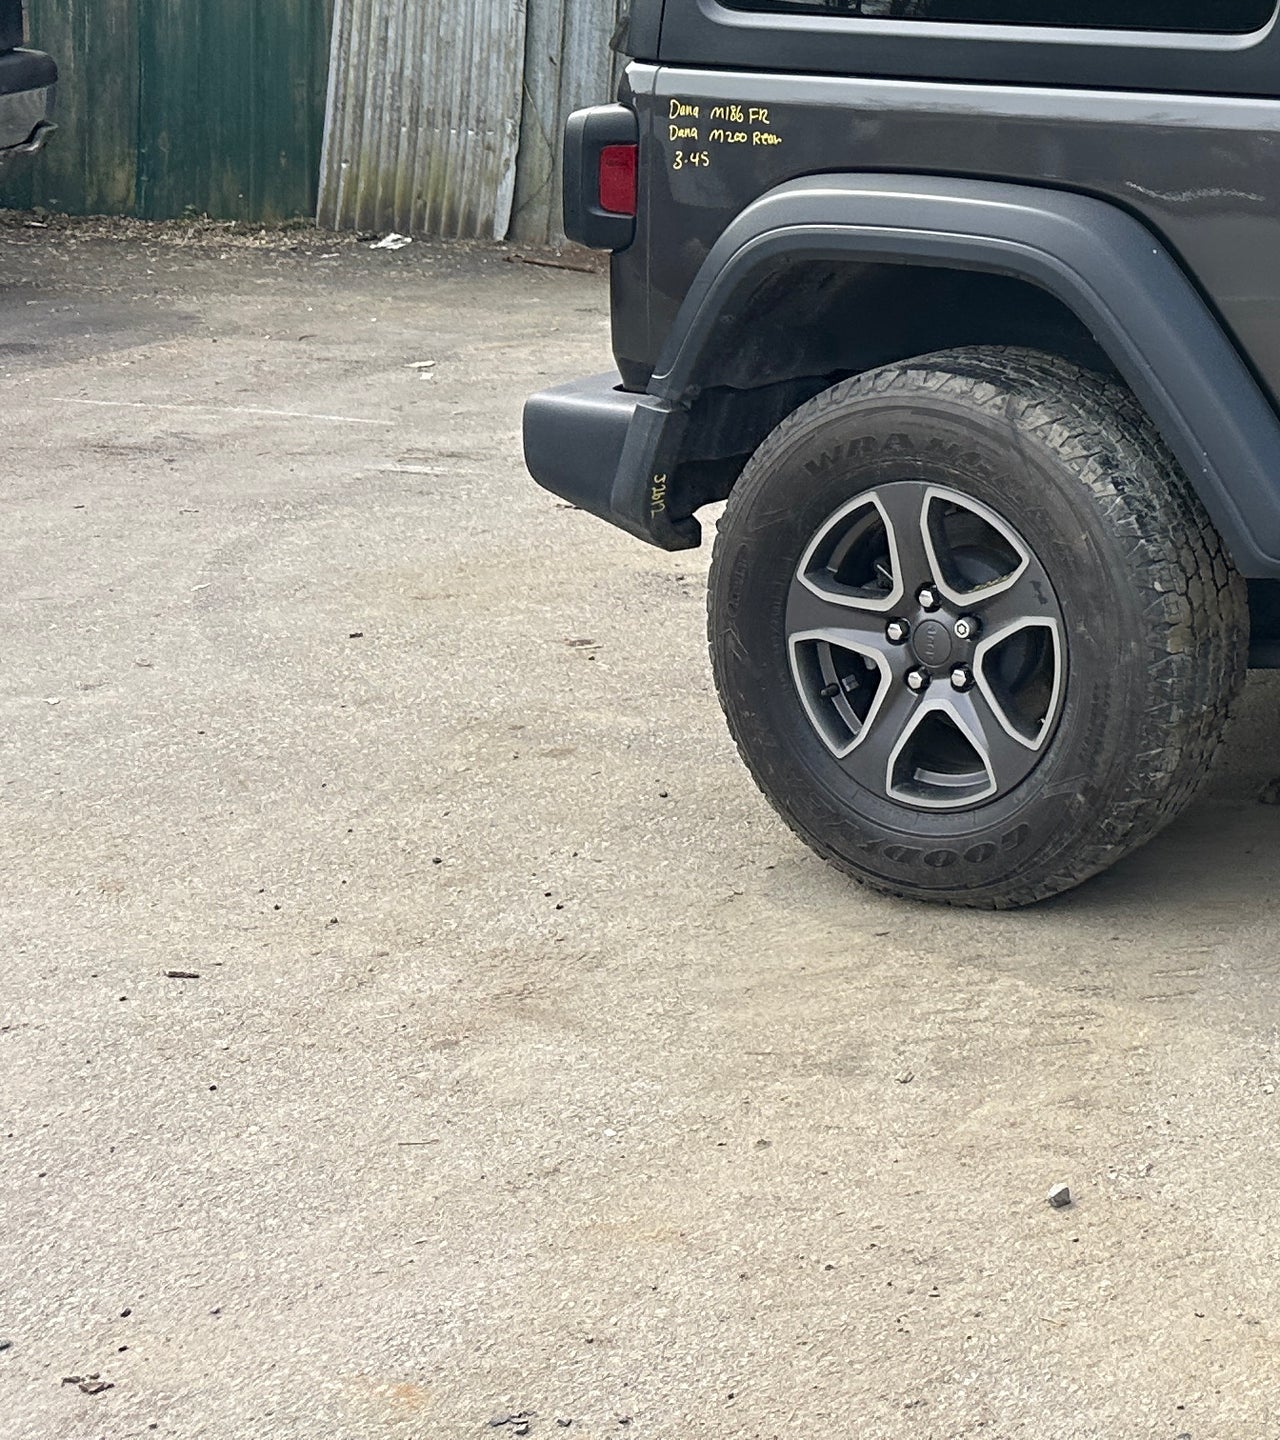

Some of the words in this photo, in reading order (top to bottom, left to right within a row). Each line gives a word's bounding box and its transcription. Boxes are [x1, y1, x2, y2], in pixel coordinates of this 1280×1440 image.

[668, 99, 698, 120] Dana
[748, 108, 770, 124] FR
[668, 125, 698, 141] Dana
